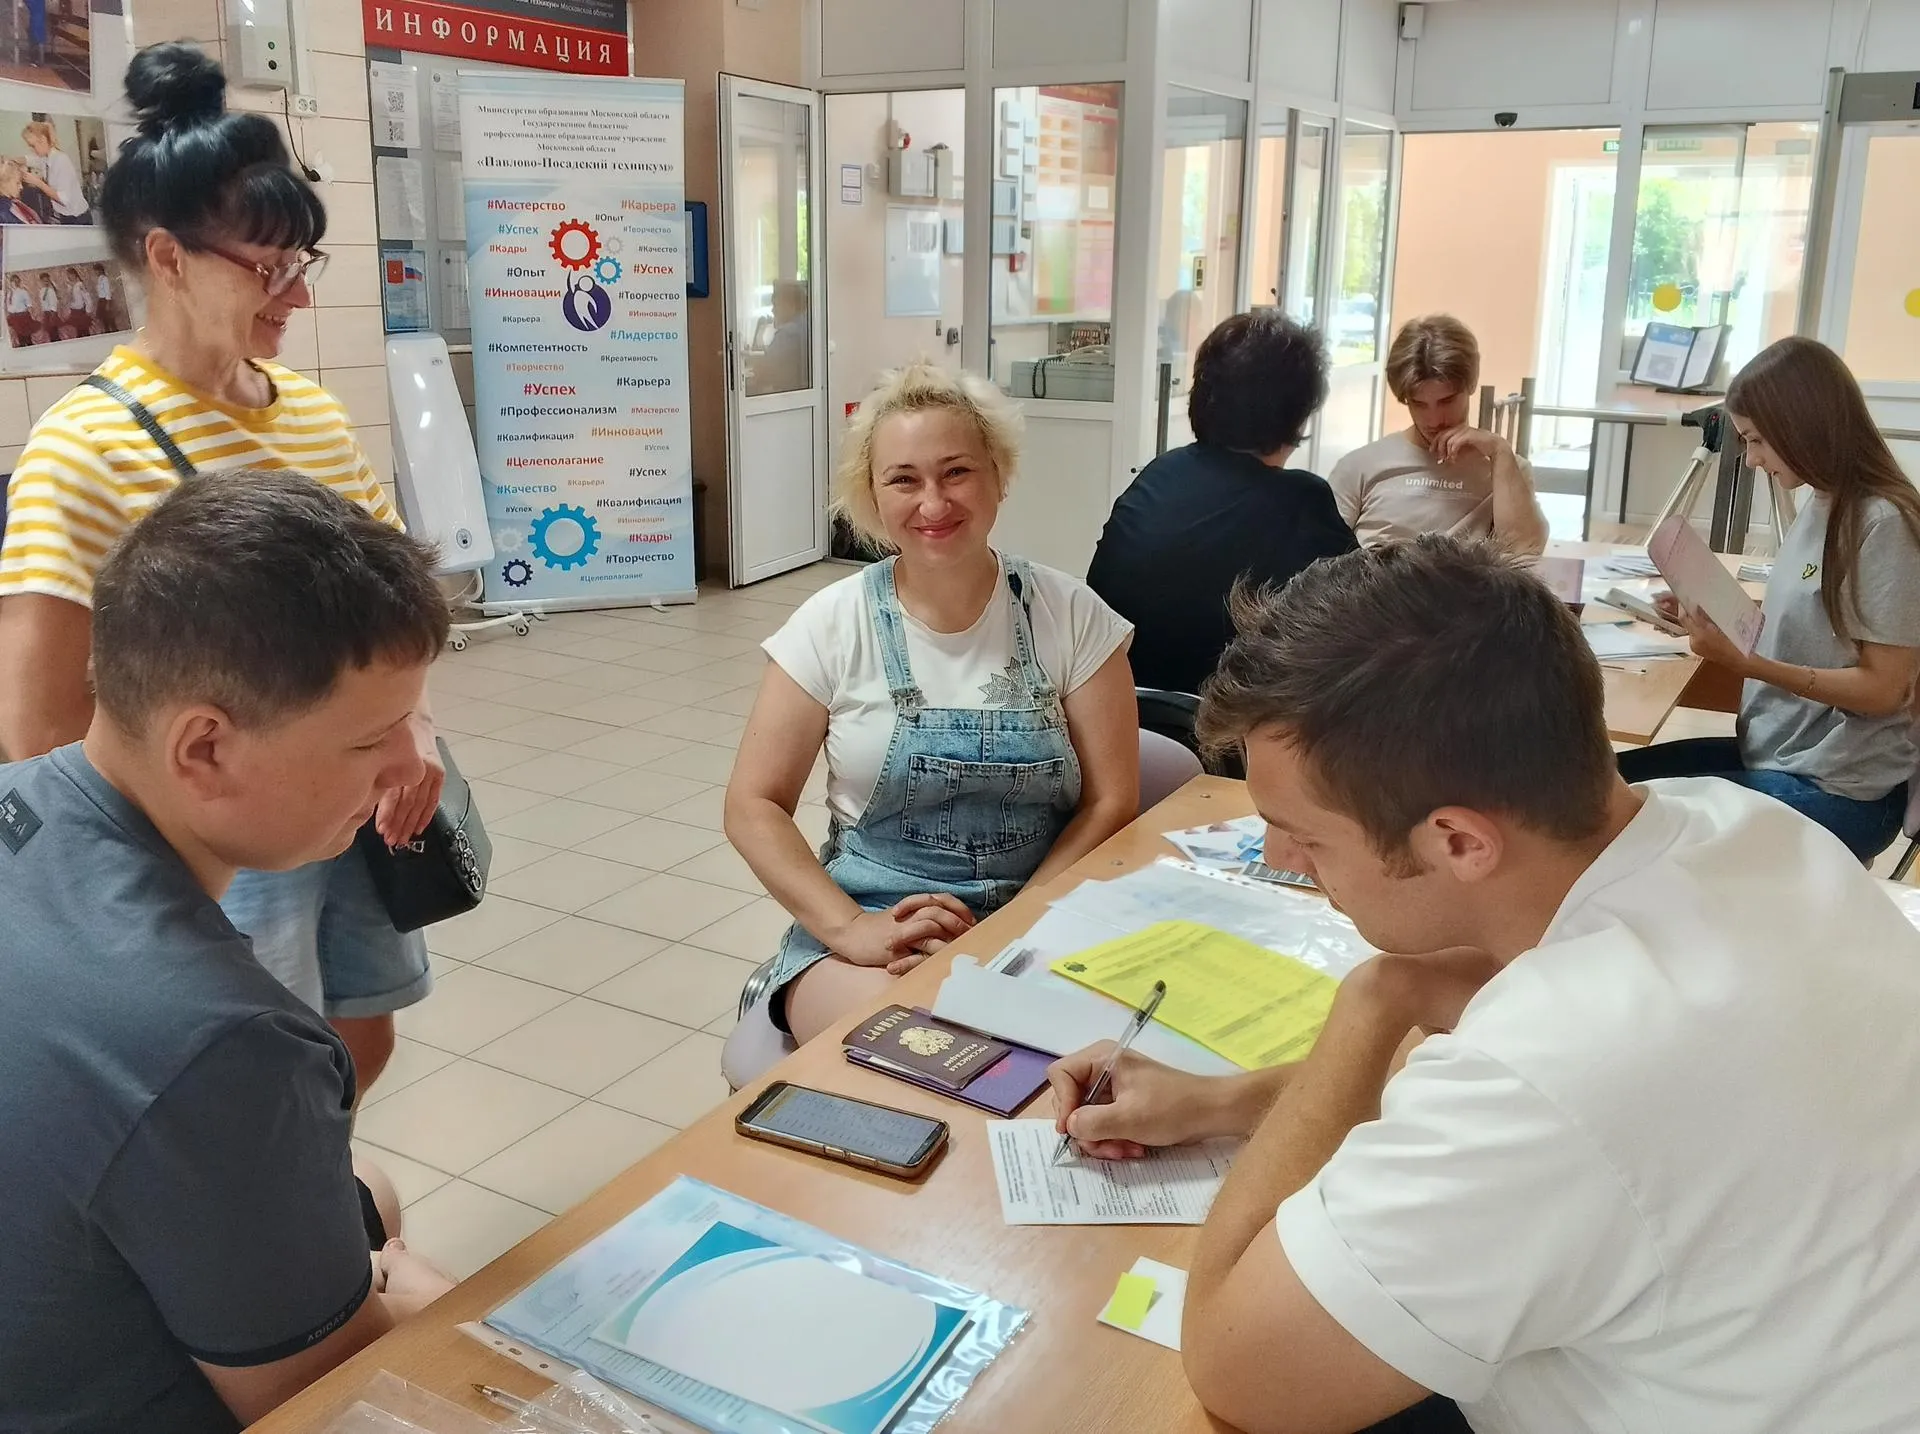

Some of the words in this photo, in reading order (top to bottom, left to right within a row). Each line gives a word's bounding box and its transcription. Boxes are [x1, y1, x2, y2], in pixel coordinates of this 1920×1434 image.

[375, 7, 612, 64] ИНФОРМАЦИЯ
[478, 106, 536, 116] Министерство
[539, 108, 588, 117] образования
[591, 109, 637, 119] Московской
[522, 120, 586, 128] Государственное
[588, 121, 629, 130] бюджетное
[484, 131, 556, 139] профессиональное
[558, 132, 620, 141] образовательное
[537, 143, 584, 152] Московской
[586, 145, 616, 153] области
[477, 156, 607, 169] «Павлово-Посадский
[613, 162, 674, 174] техникум»
[487, 200, 565, 211] #Мастерство
[621, 200, 676, 212] #Карьера
[595, 214, 624, 222] #Опыт
[499, 224, 539, 235] #Успех
[624, 226, 671, 234] #Творчество
[489, 244, 527, 253] #Кадры
[507, 267, 545, 277] #Опыт
[633, 264, 674, 274] #Успех
[485, 288, 561, 299] #Инновации
[618, 292, 680, 301] #Творчество
[502, 315, 540, 323] #Карьера
[610, 331, 678, 341] #Лидерство
[489, 343, 588, 353] #Компетентность
[601, 355, 658, 363] #Креативность
[506, 364, 564, 373] #Творчество
[617, 378, 671, 388] #Карьера
[524, 384, 576, 396] #Успех
[500, 406, 617, 418] #Профессионализм
[591, 427, 663, 437] #Инновации
[497, 433, 574, 442] #Квалификация
[506, 456, 604, 467] #Целеполагание
[630, 467, 667, 477] #Успех
[1406, 478, 1463, 489] unlimited
[497, 485, 557, 494] #Качество
[597, 497, 682, 508] #Квалификация
[629, 533, 672, 543] #Кадры
[606, 553, 675, 564] #Творчество
[580, 573, 643, 582] #Целеполагание
[862, 1011, 911, 1042] ПАСПОРТ
[943, 1043, 978, 1067] ФЕДЕРАЦИЯ
[949, 1044, 989, 1072] РОССИЙСКАЯ
